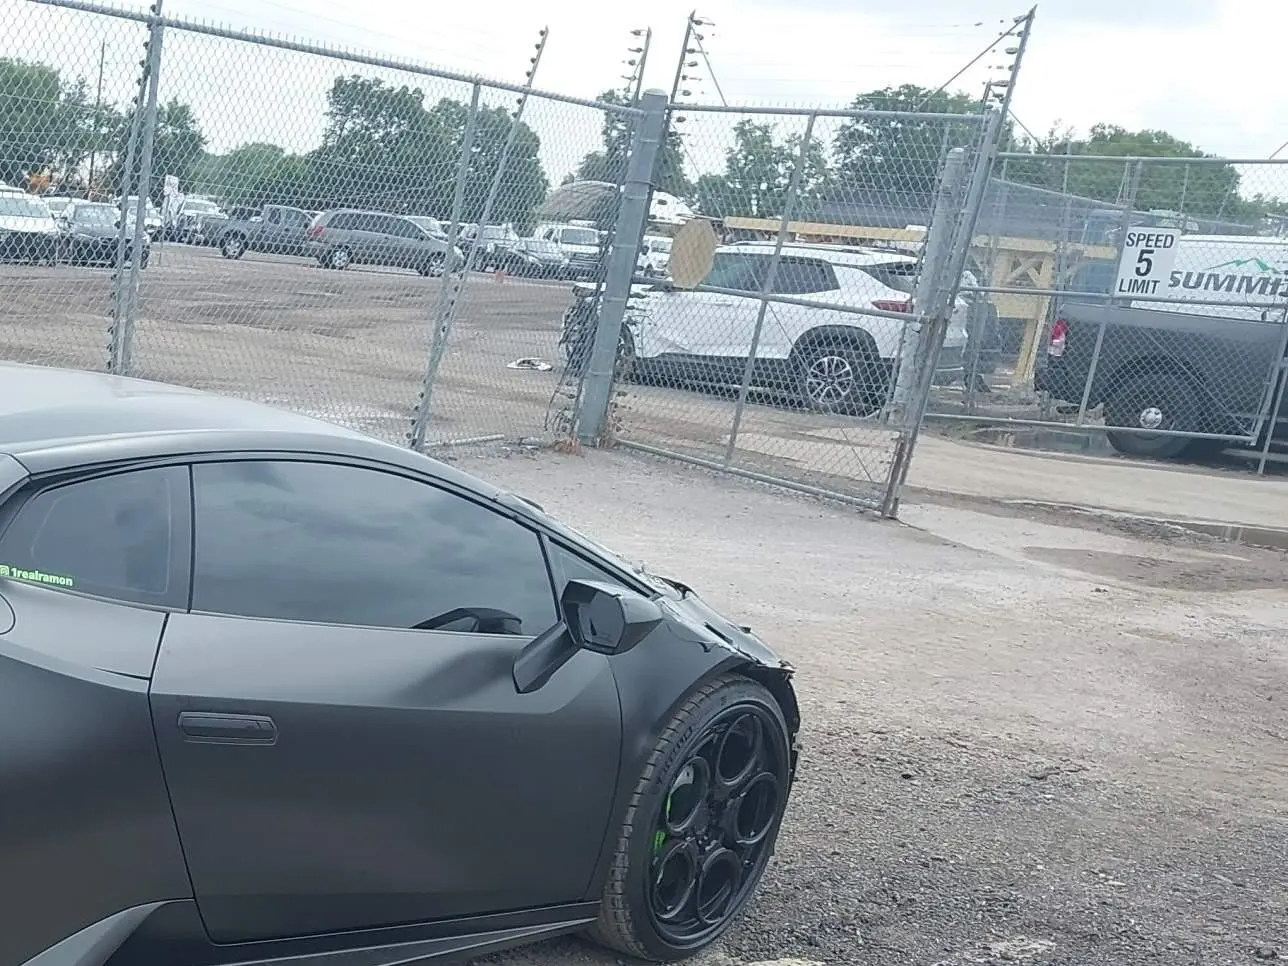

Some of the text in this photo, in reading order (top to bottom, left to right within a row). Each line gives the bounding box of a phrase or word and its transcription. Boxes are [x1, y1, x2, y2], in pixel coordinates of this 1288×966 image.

[1126, 232, 1174, 249] SPEED
[1135, 249, 1155, 277] 5
[1118, 278, 1160, 294] LIMIT
[1168, 270, 1288, 297] SUMMI
